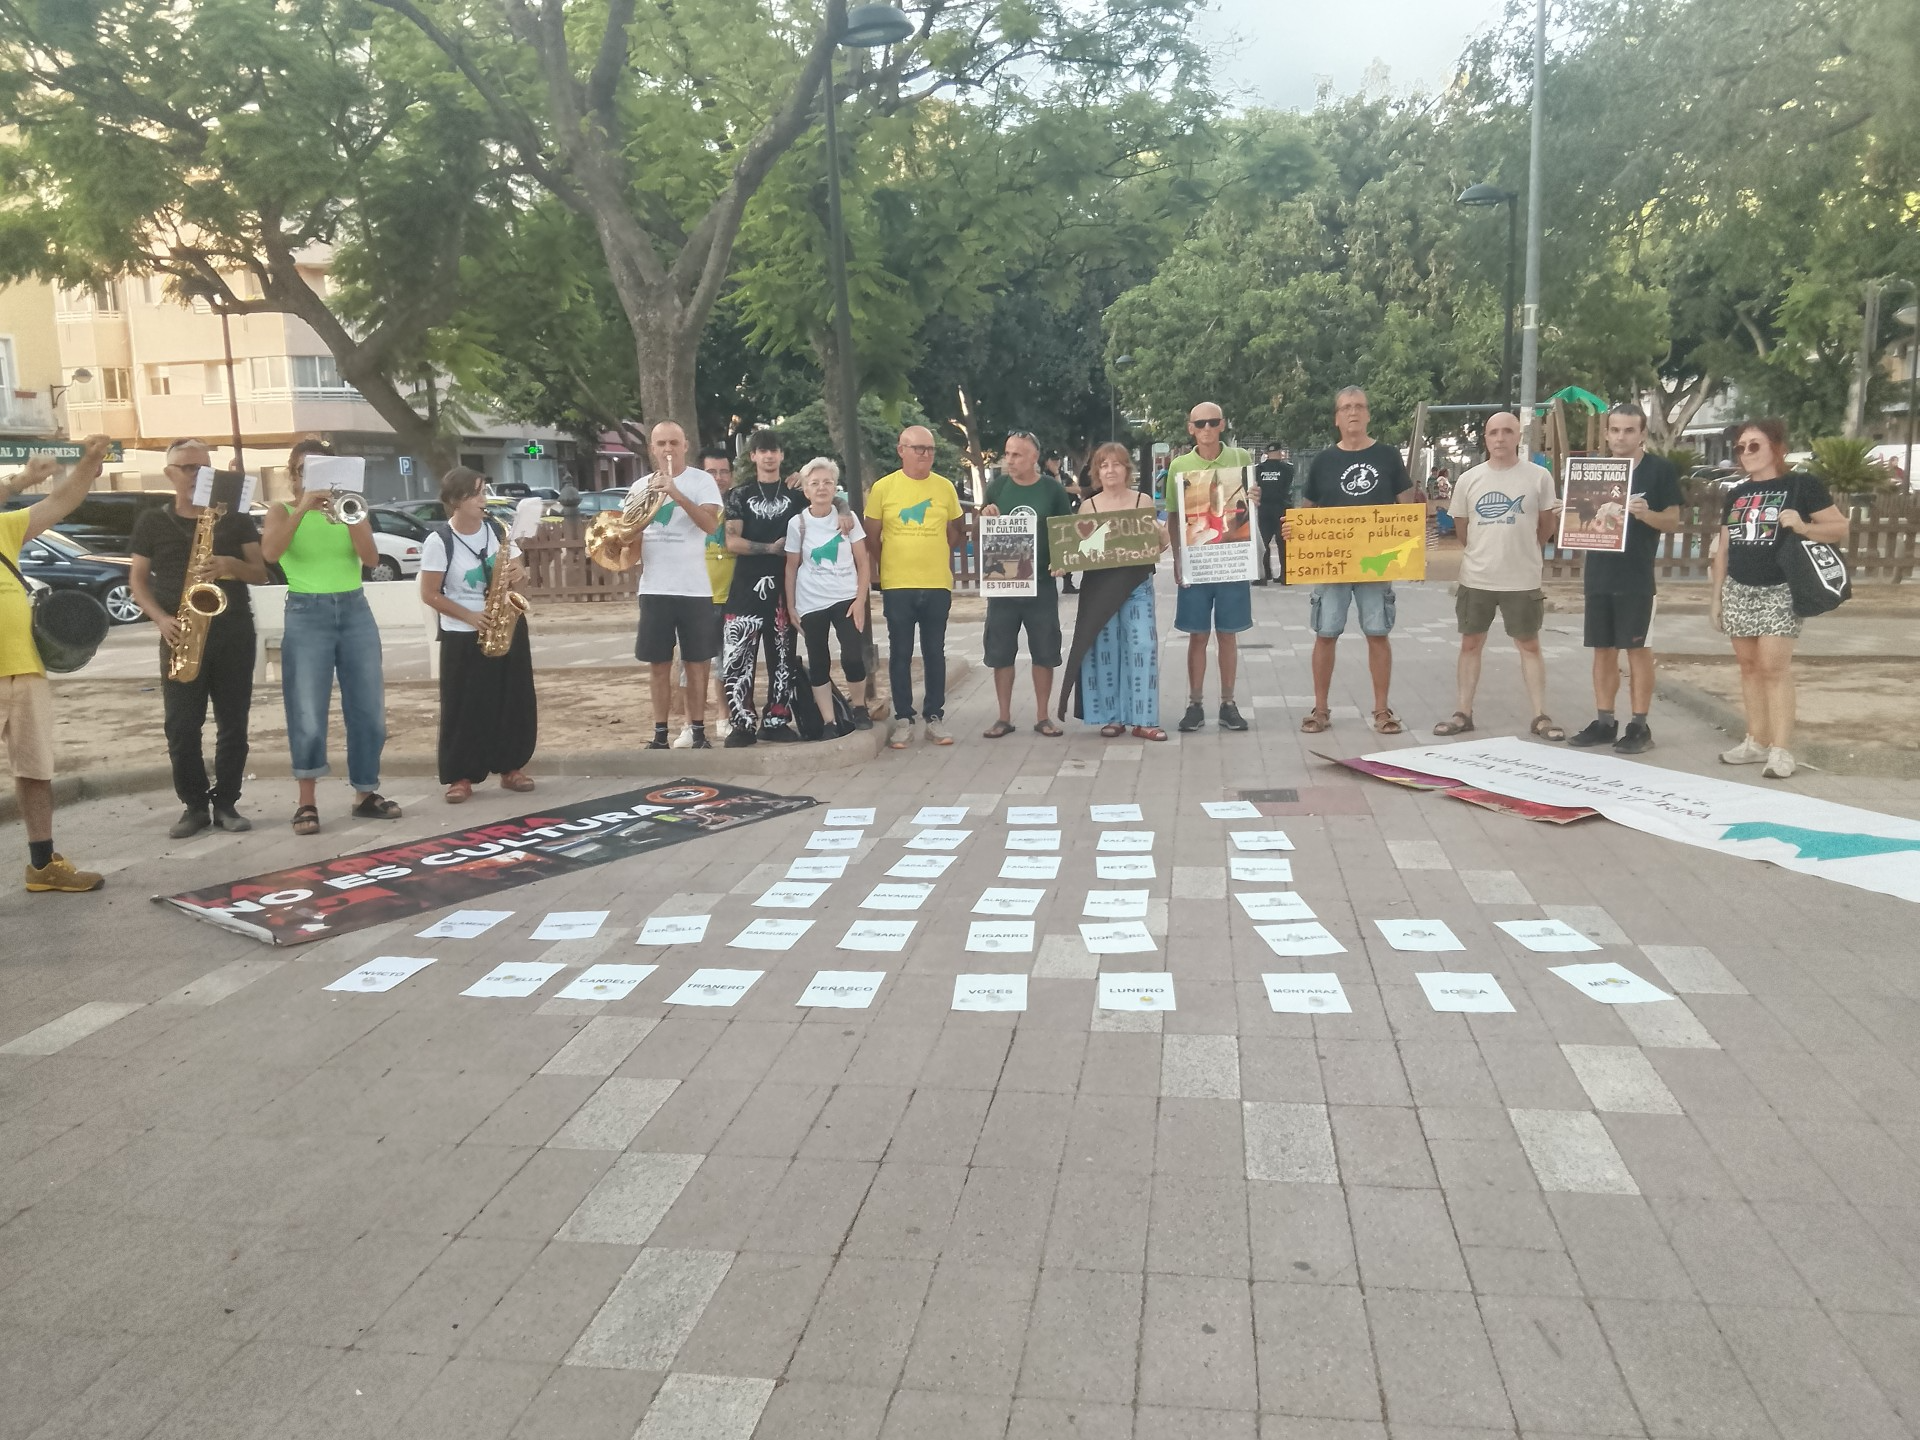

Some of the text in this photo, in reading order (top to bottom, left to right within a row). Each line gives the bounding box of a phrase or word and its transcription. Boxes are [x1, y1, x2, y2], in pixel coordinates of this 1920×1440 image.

[403, 461, 410, 473] P
[1582, 463, 1627, 471] SUBVENCIONES
[1571, 471, 1626, 481] NO SOIS NADA
[1009, 518, 1028, 526] ARTE
[1296, 514, 1367, 526] Subvencions
[996, 526, 1028, 534] CULTURA
[1052, 523, 1073, 545] I
[1298, 527, 1355, 541] educació
[1368, 525, 1411, 543] pública
[1062, 550, 1080, 565] in
[1298, 548, 1352, 559] bombers
[1298, 560, 1347, 577] sanitat
[207, 804, 674, 917] NO ES CULTURA
[973, 932, 1029, 940] CIGARRO
[579, 977, 637, 985] CANDELO
[968, 987, 1013, 995] VOCES
[1109, 986, 1165, 994] LUNERO
